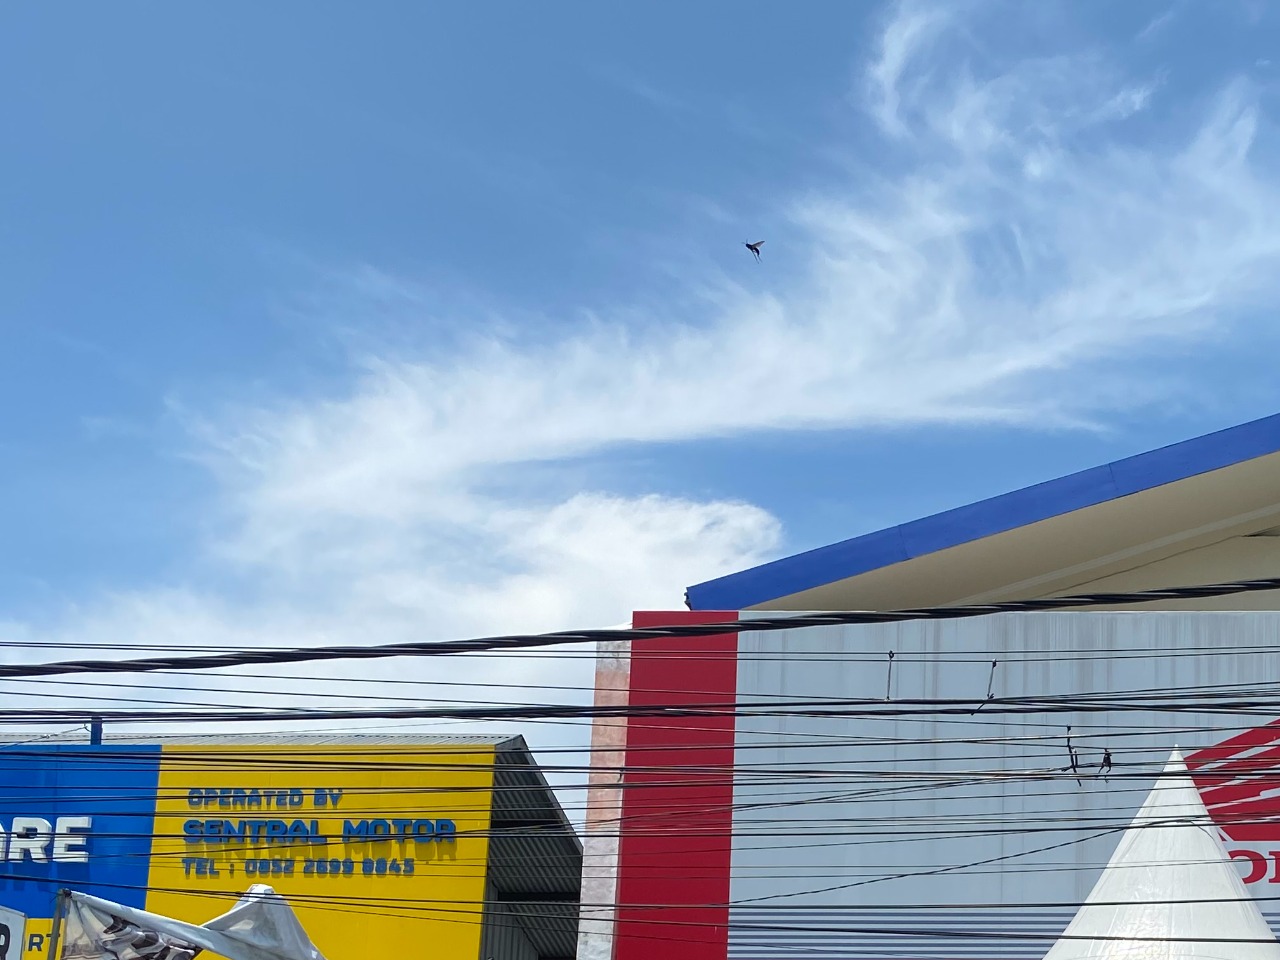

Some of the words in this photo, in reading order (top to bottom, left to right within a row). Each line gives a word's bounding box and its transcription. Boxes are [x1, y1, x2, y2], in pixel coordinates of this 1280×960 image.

[188, 788, 304, 807] OPERATED
[313, 788, 343, 808] BY
[0, 816, 92, 863] RE
[183, 819, 327, 844] SENTRAL
[342, 819, 457, 844] MOTOR
[182, 857, 220, 877] TEL
